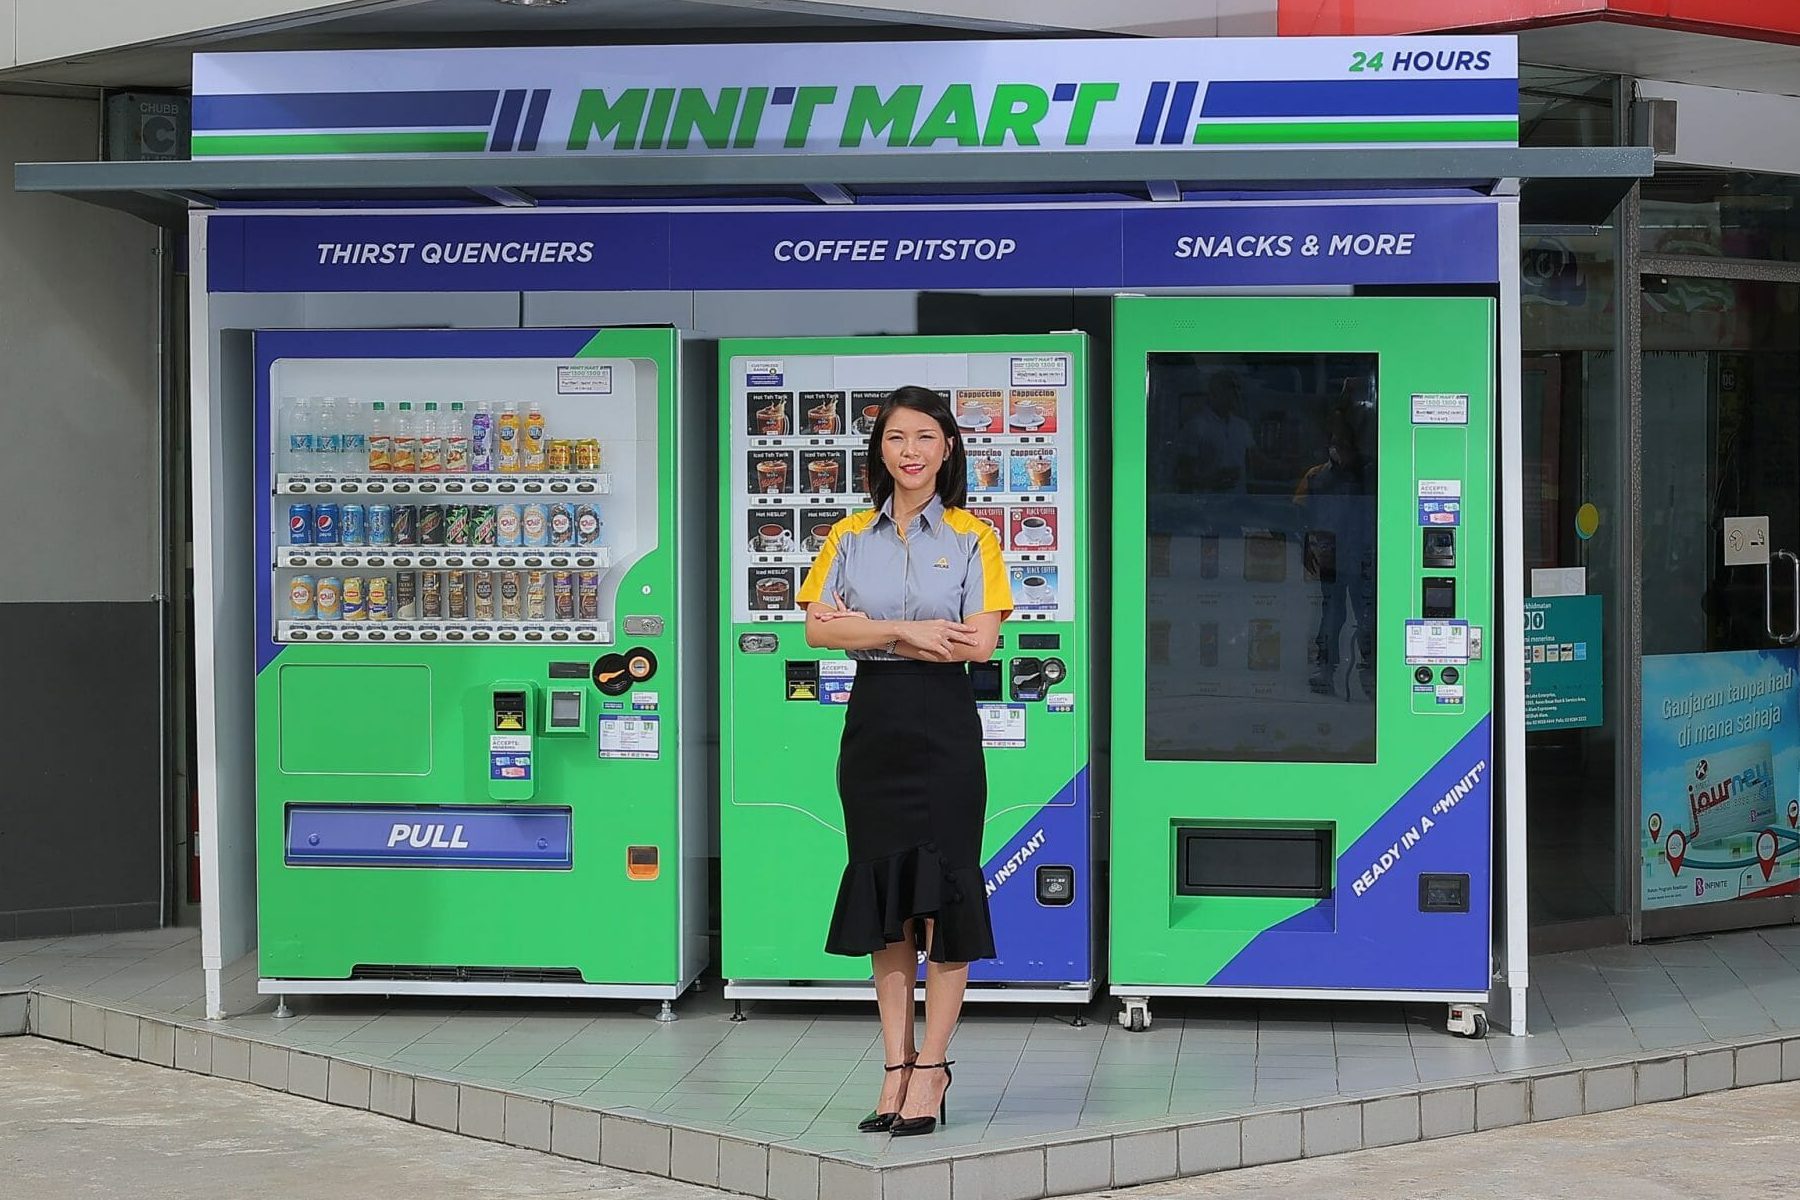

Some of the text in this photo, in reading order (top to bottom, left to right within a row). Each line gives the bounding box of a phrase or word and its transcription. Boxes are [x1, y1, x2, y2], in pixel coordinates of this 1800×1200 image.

[1349, 50, 1492, 72] 24 HOURS
[140, 102, 179, 114] CHUBB
[566, 83, 1120, 150] MINIT MART
[317, 242, 595, 264] THIRST QUENCHERS
[774, 239, 1016, 262] COFFEE PITSTOP
[1174, 233, 1416, 258] SNACKS & MORE
[1663, 667, 1793, 719] Ganjaran tanpa had
[1678, 703, 1781, 749] di mana sahaja
[387, 824, 469, 849] PULL
[994, 829, 1047, 886] INSTANT
[1351, 843, 1401, 897] READY
[1401, 826, 1421, 850] IN
[1420, 816, 1435, 833] A
